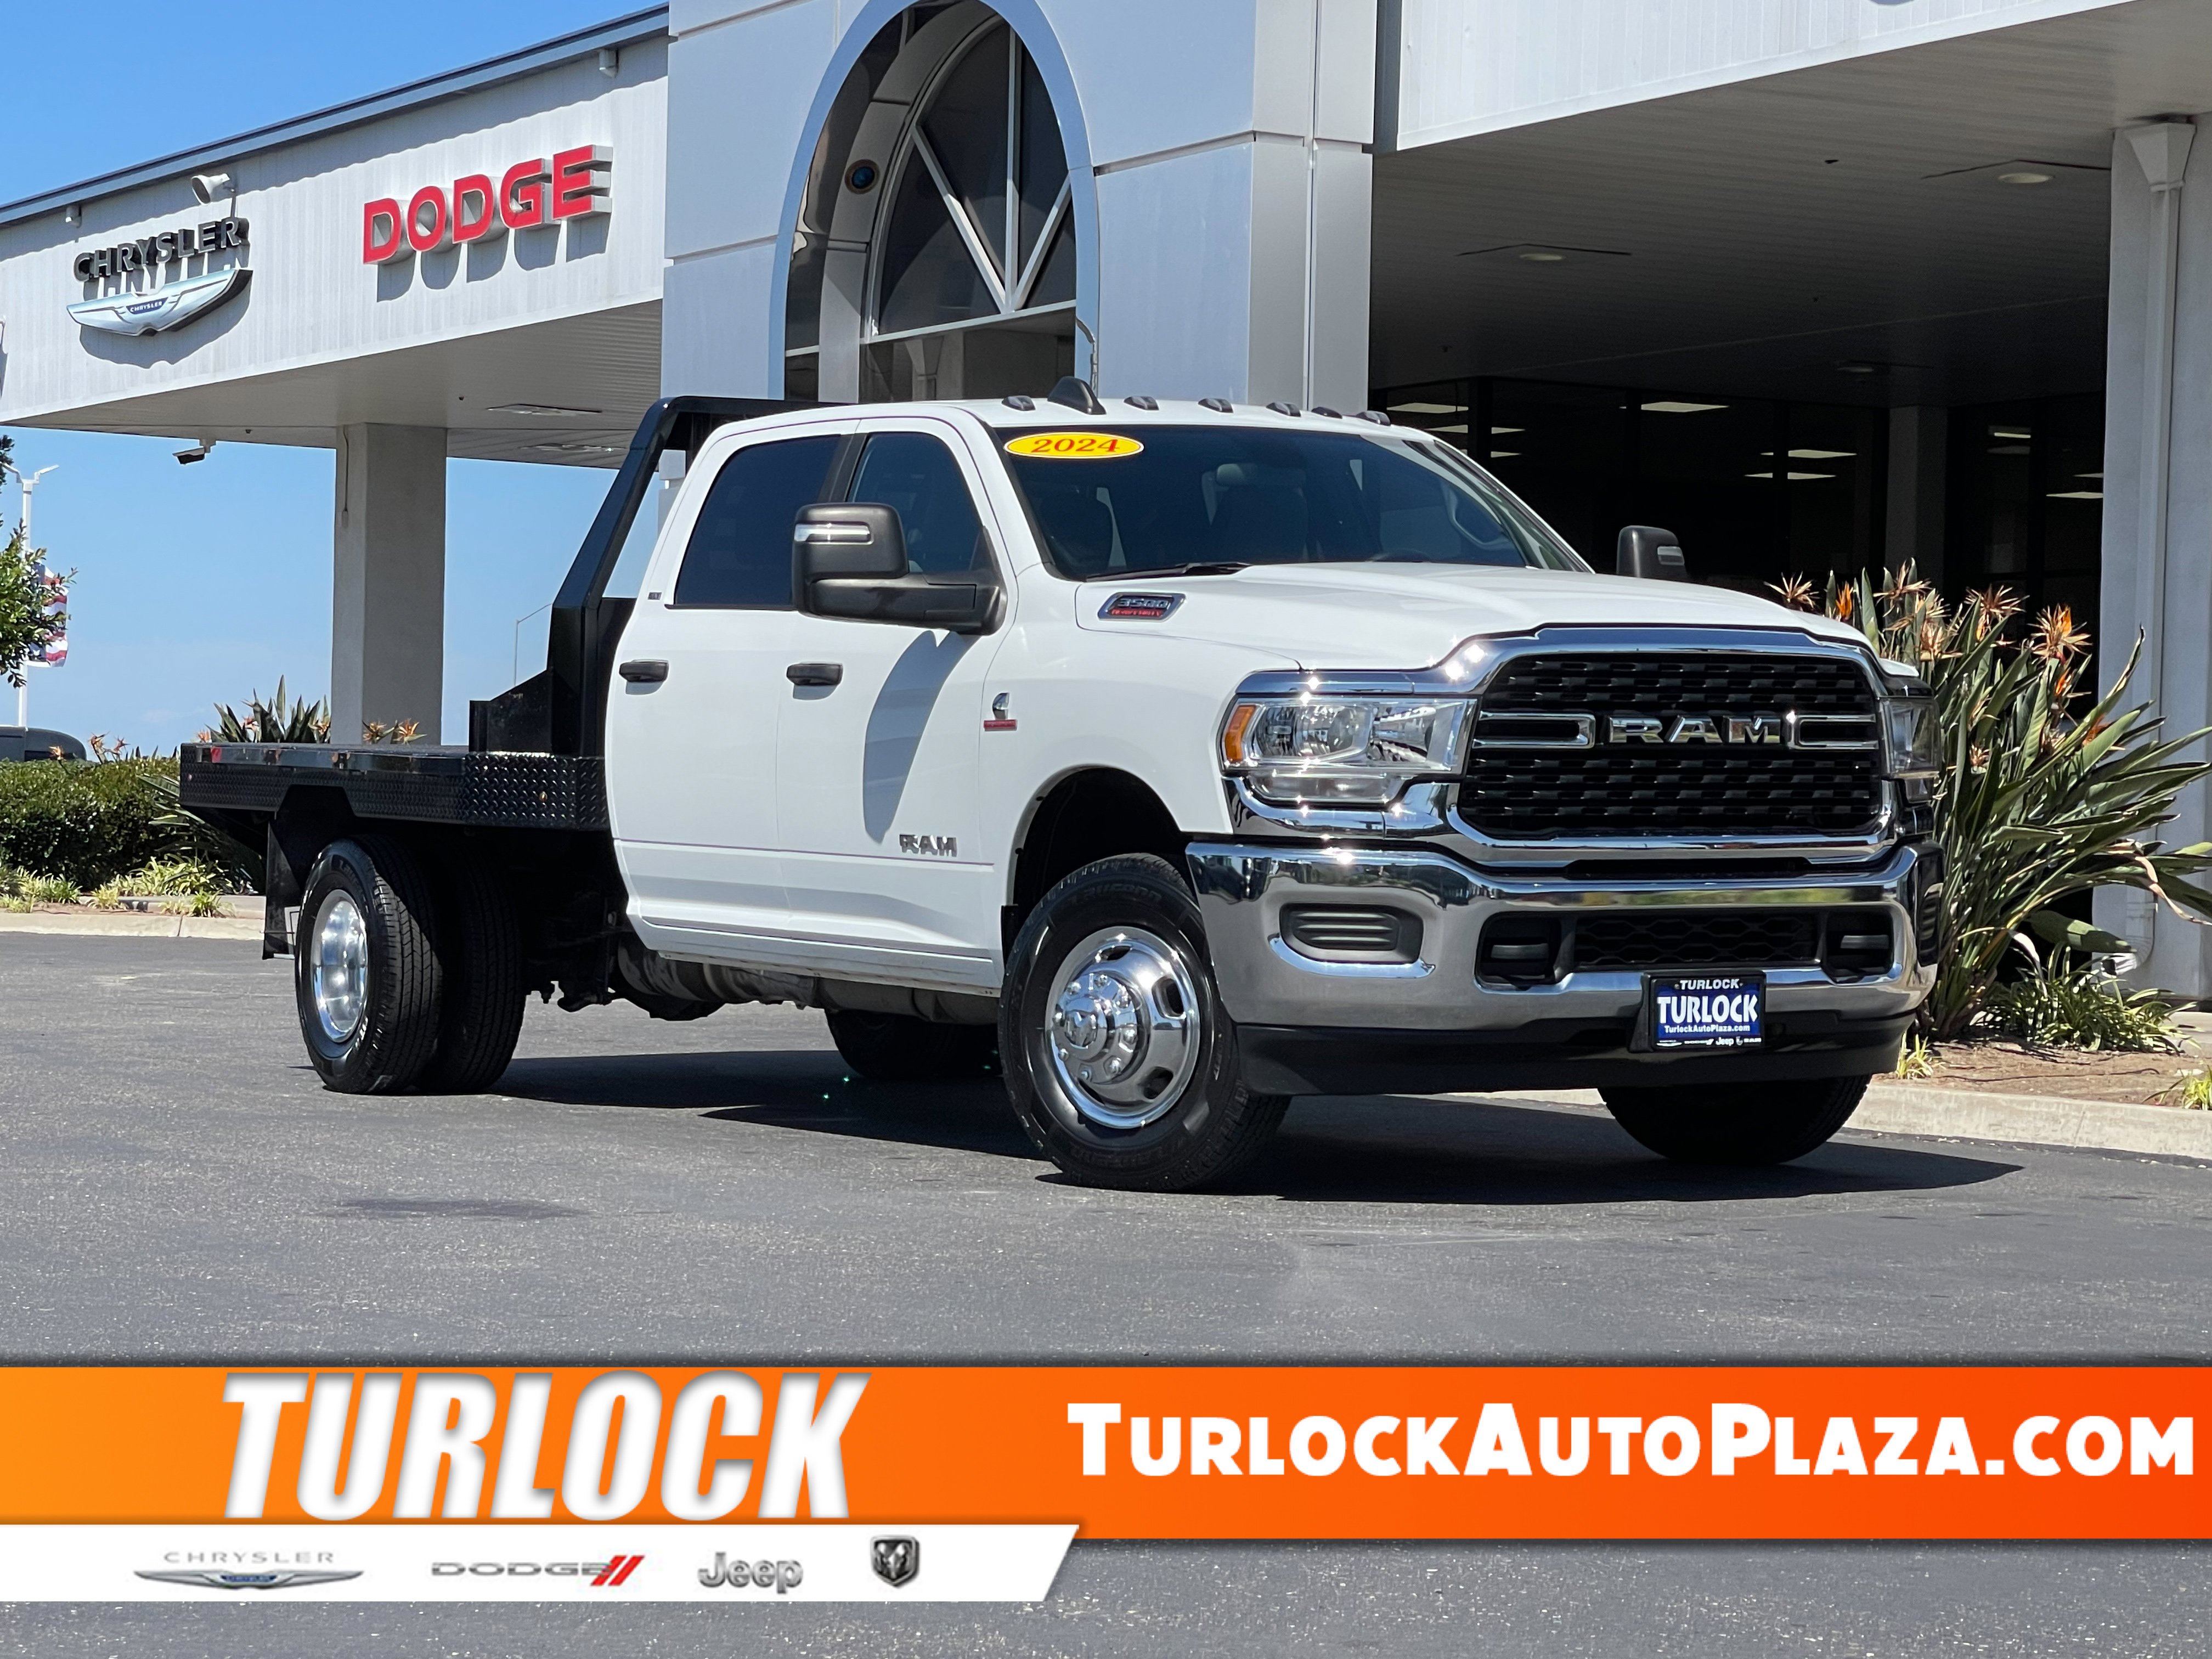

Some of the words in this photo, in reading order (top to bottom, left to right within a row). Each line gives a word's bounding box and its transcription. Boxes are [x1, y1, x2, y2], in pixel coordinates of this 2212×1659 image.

[364, 145, 597, 264] DODGE
[74, 217, 242, 282] CHRYSLER
[130, 301, 163, 312] CHRYSLER
[1031, 438, 1120, 453] 2024
[1610, 714, 1781, 743] RAM
[899, 834, 957, 854] RAM
[1680, 979, 1740, 990] TURLOCK
[1657, 994, 1758, 1024] TURLOCK
[1664, 1024, 1750, 1033] TurlockAutoPlaza.com
[1716, 1037, 1734, 1046] Jeep
